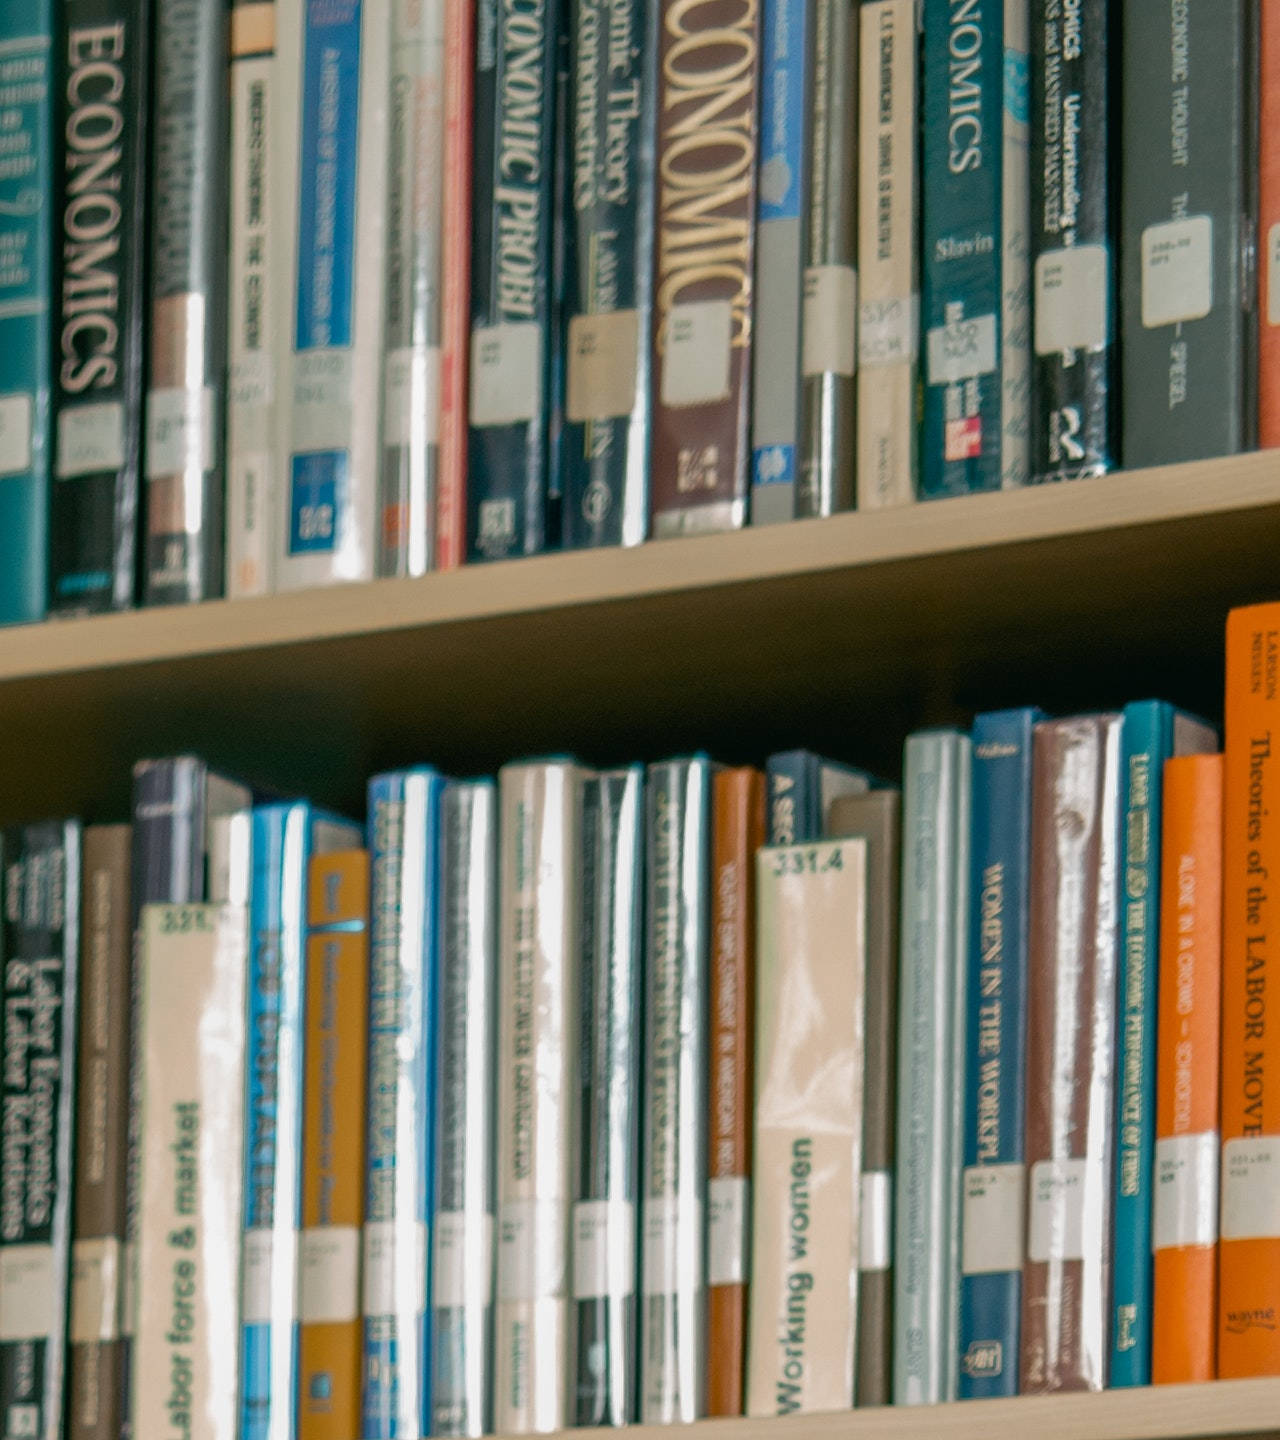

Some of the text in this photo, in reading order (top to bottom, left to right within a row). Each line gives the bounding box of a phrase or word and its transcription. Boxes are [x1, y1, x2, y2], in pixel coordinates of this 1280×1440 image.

[62, 25, 124, 392] ECONOMICS
[775, 852, 844, 874] 331.4
[1243, 732, 1272, 1043] Theories of the LABOR
[173, 1101, 200, 1214] market
[170, 1224, 193, 1249] &
[778, 1138, 814, 1414] Working women
[169, 1259, 193, 1345] force
